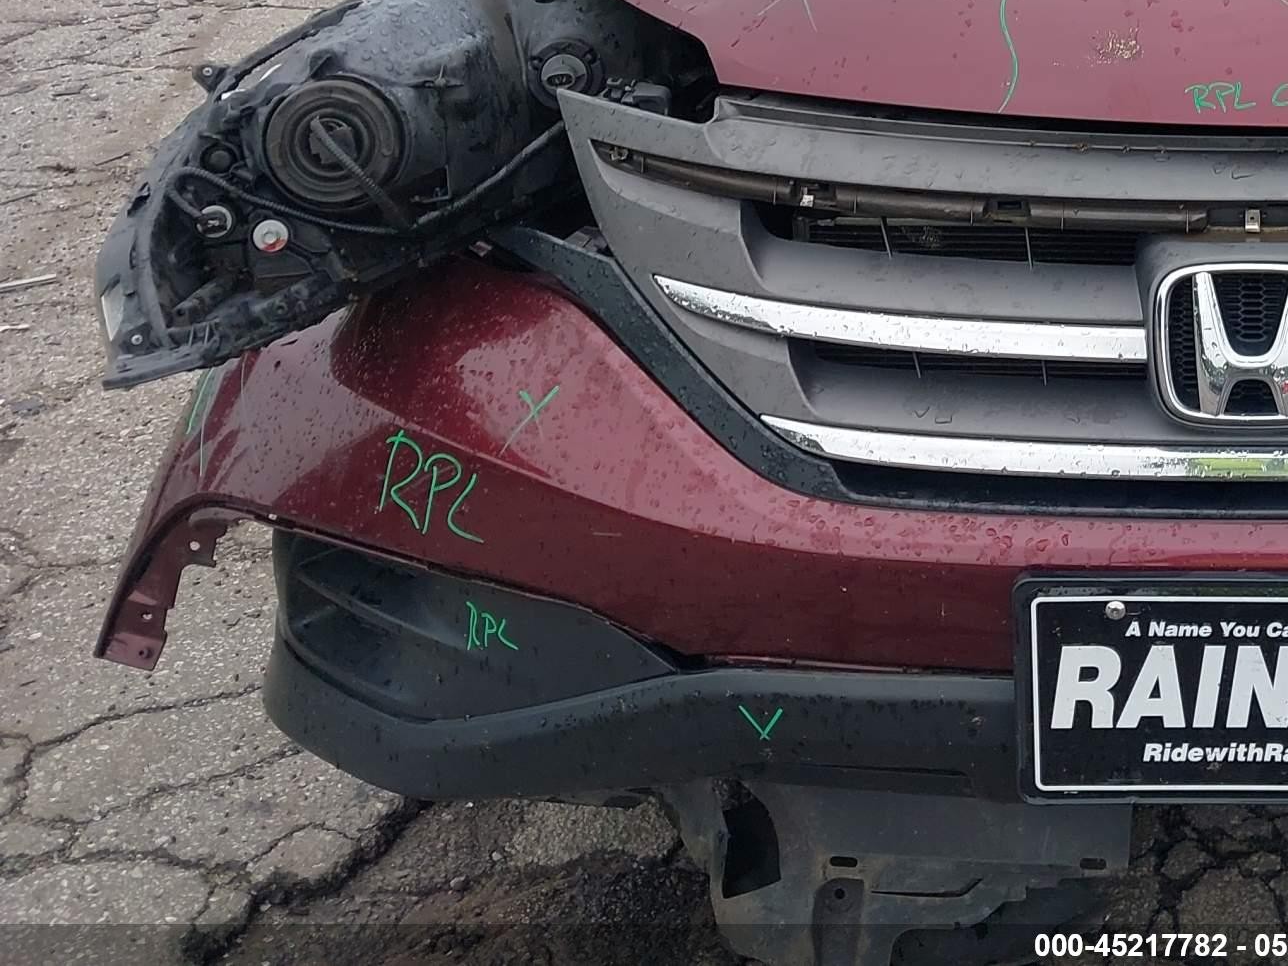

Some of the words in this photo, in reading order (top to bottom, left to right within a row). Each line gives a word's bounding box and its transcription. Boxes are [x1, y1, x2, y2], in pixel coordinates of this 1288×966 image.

[1184, 81, 1257, 114] RPL
[379, 429, 485, 544] RPL
[1125, 621, 1141, 638] A
[1148, 621, 1213, 638] Name
[1219, 621, 1261, 638] You
